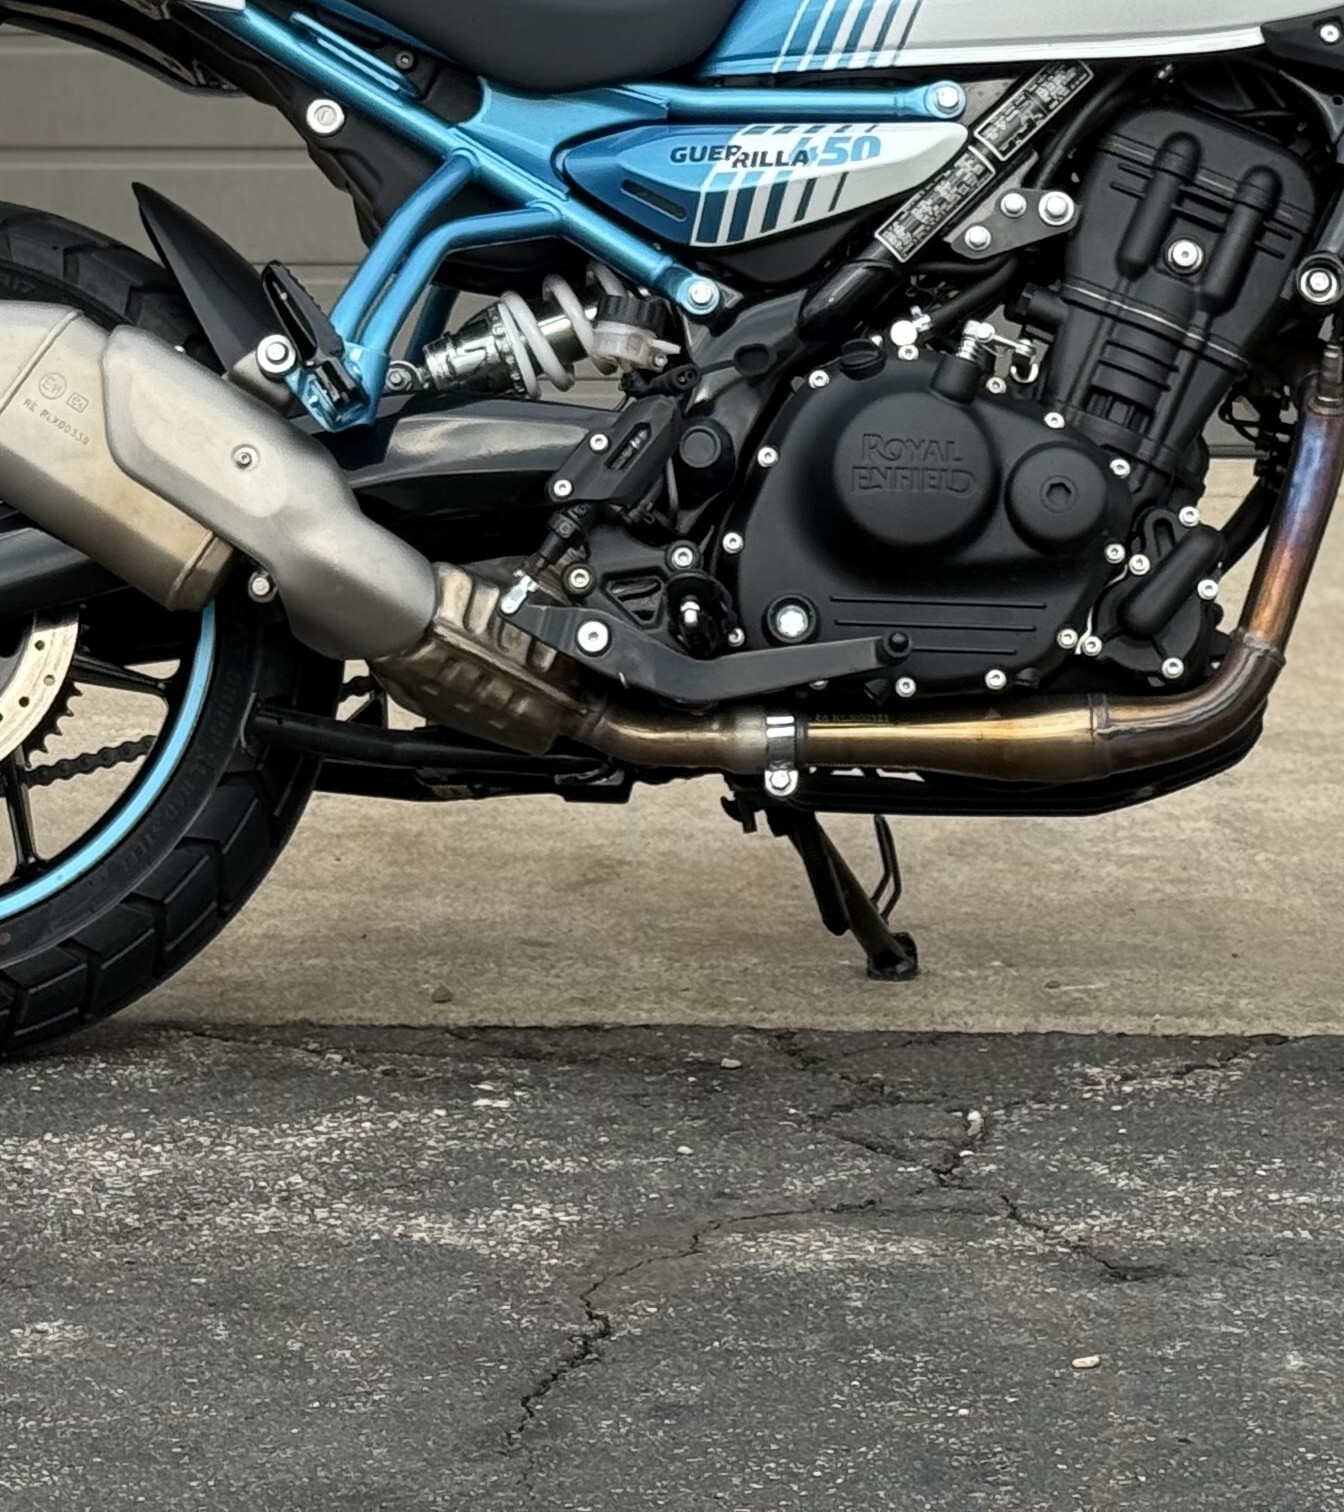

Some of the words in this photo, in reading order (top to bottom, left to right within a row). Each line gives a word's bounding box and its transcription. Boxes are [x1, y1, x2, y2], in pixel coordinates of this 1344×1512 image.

[670, 144, 810, 168] GUERRILLA
[861, 432, 964, 463] ROYAL
[851, 465, 976, 498] ENFIELD
